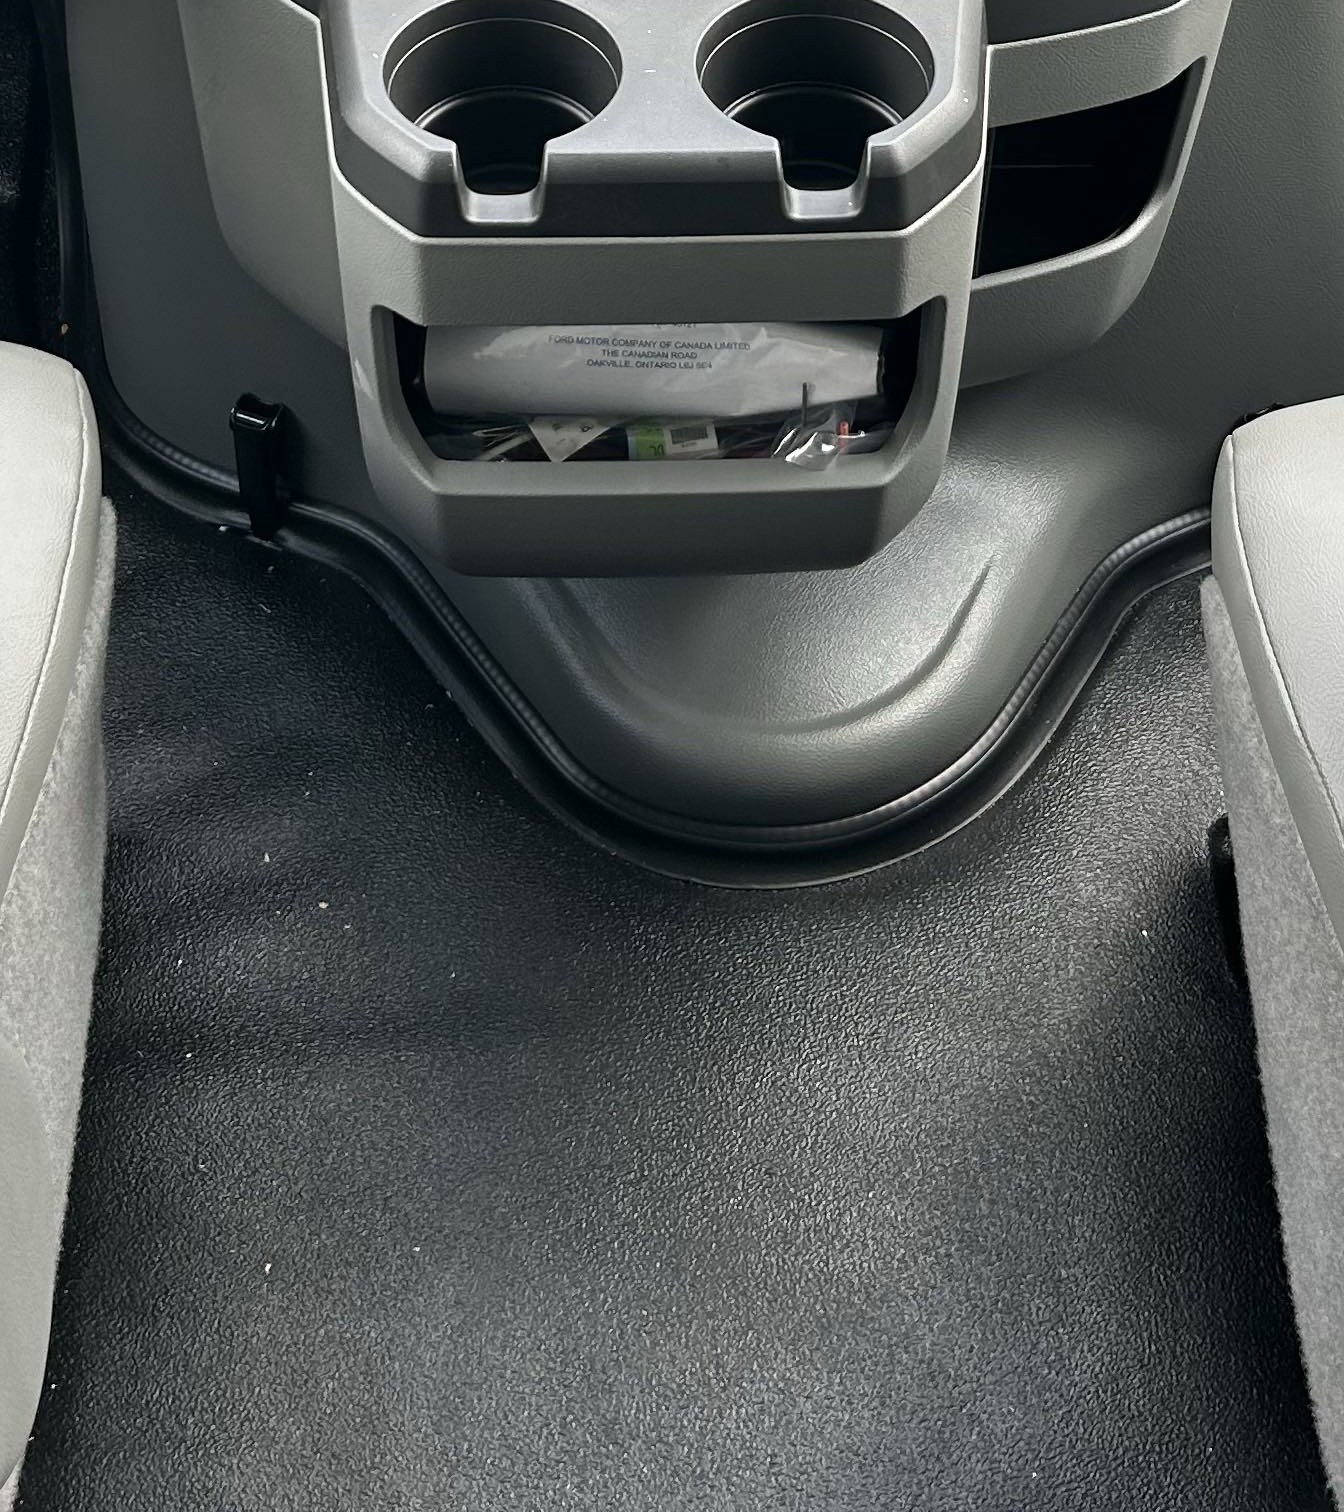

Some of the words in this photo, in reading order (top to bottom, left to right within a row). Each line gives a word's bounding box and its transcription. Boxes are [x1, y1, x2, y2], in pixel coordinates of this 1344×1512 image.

[549, 334, 574, 344] FORD
[575, 336, 609, 347] MOTOR
[612, 338, 657, 348] COMPANY
[659, 340, 673, 349] OF
[674, 341, 713, 350] CANADA
[602, 349, 619, 357] THE
[622, 350, 669, 359] CANADIAN
[671, 351, 698, 360] ROAD
[635, 360, 676, 369] ONTARIO
